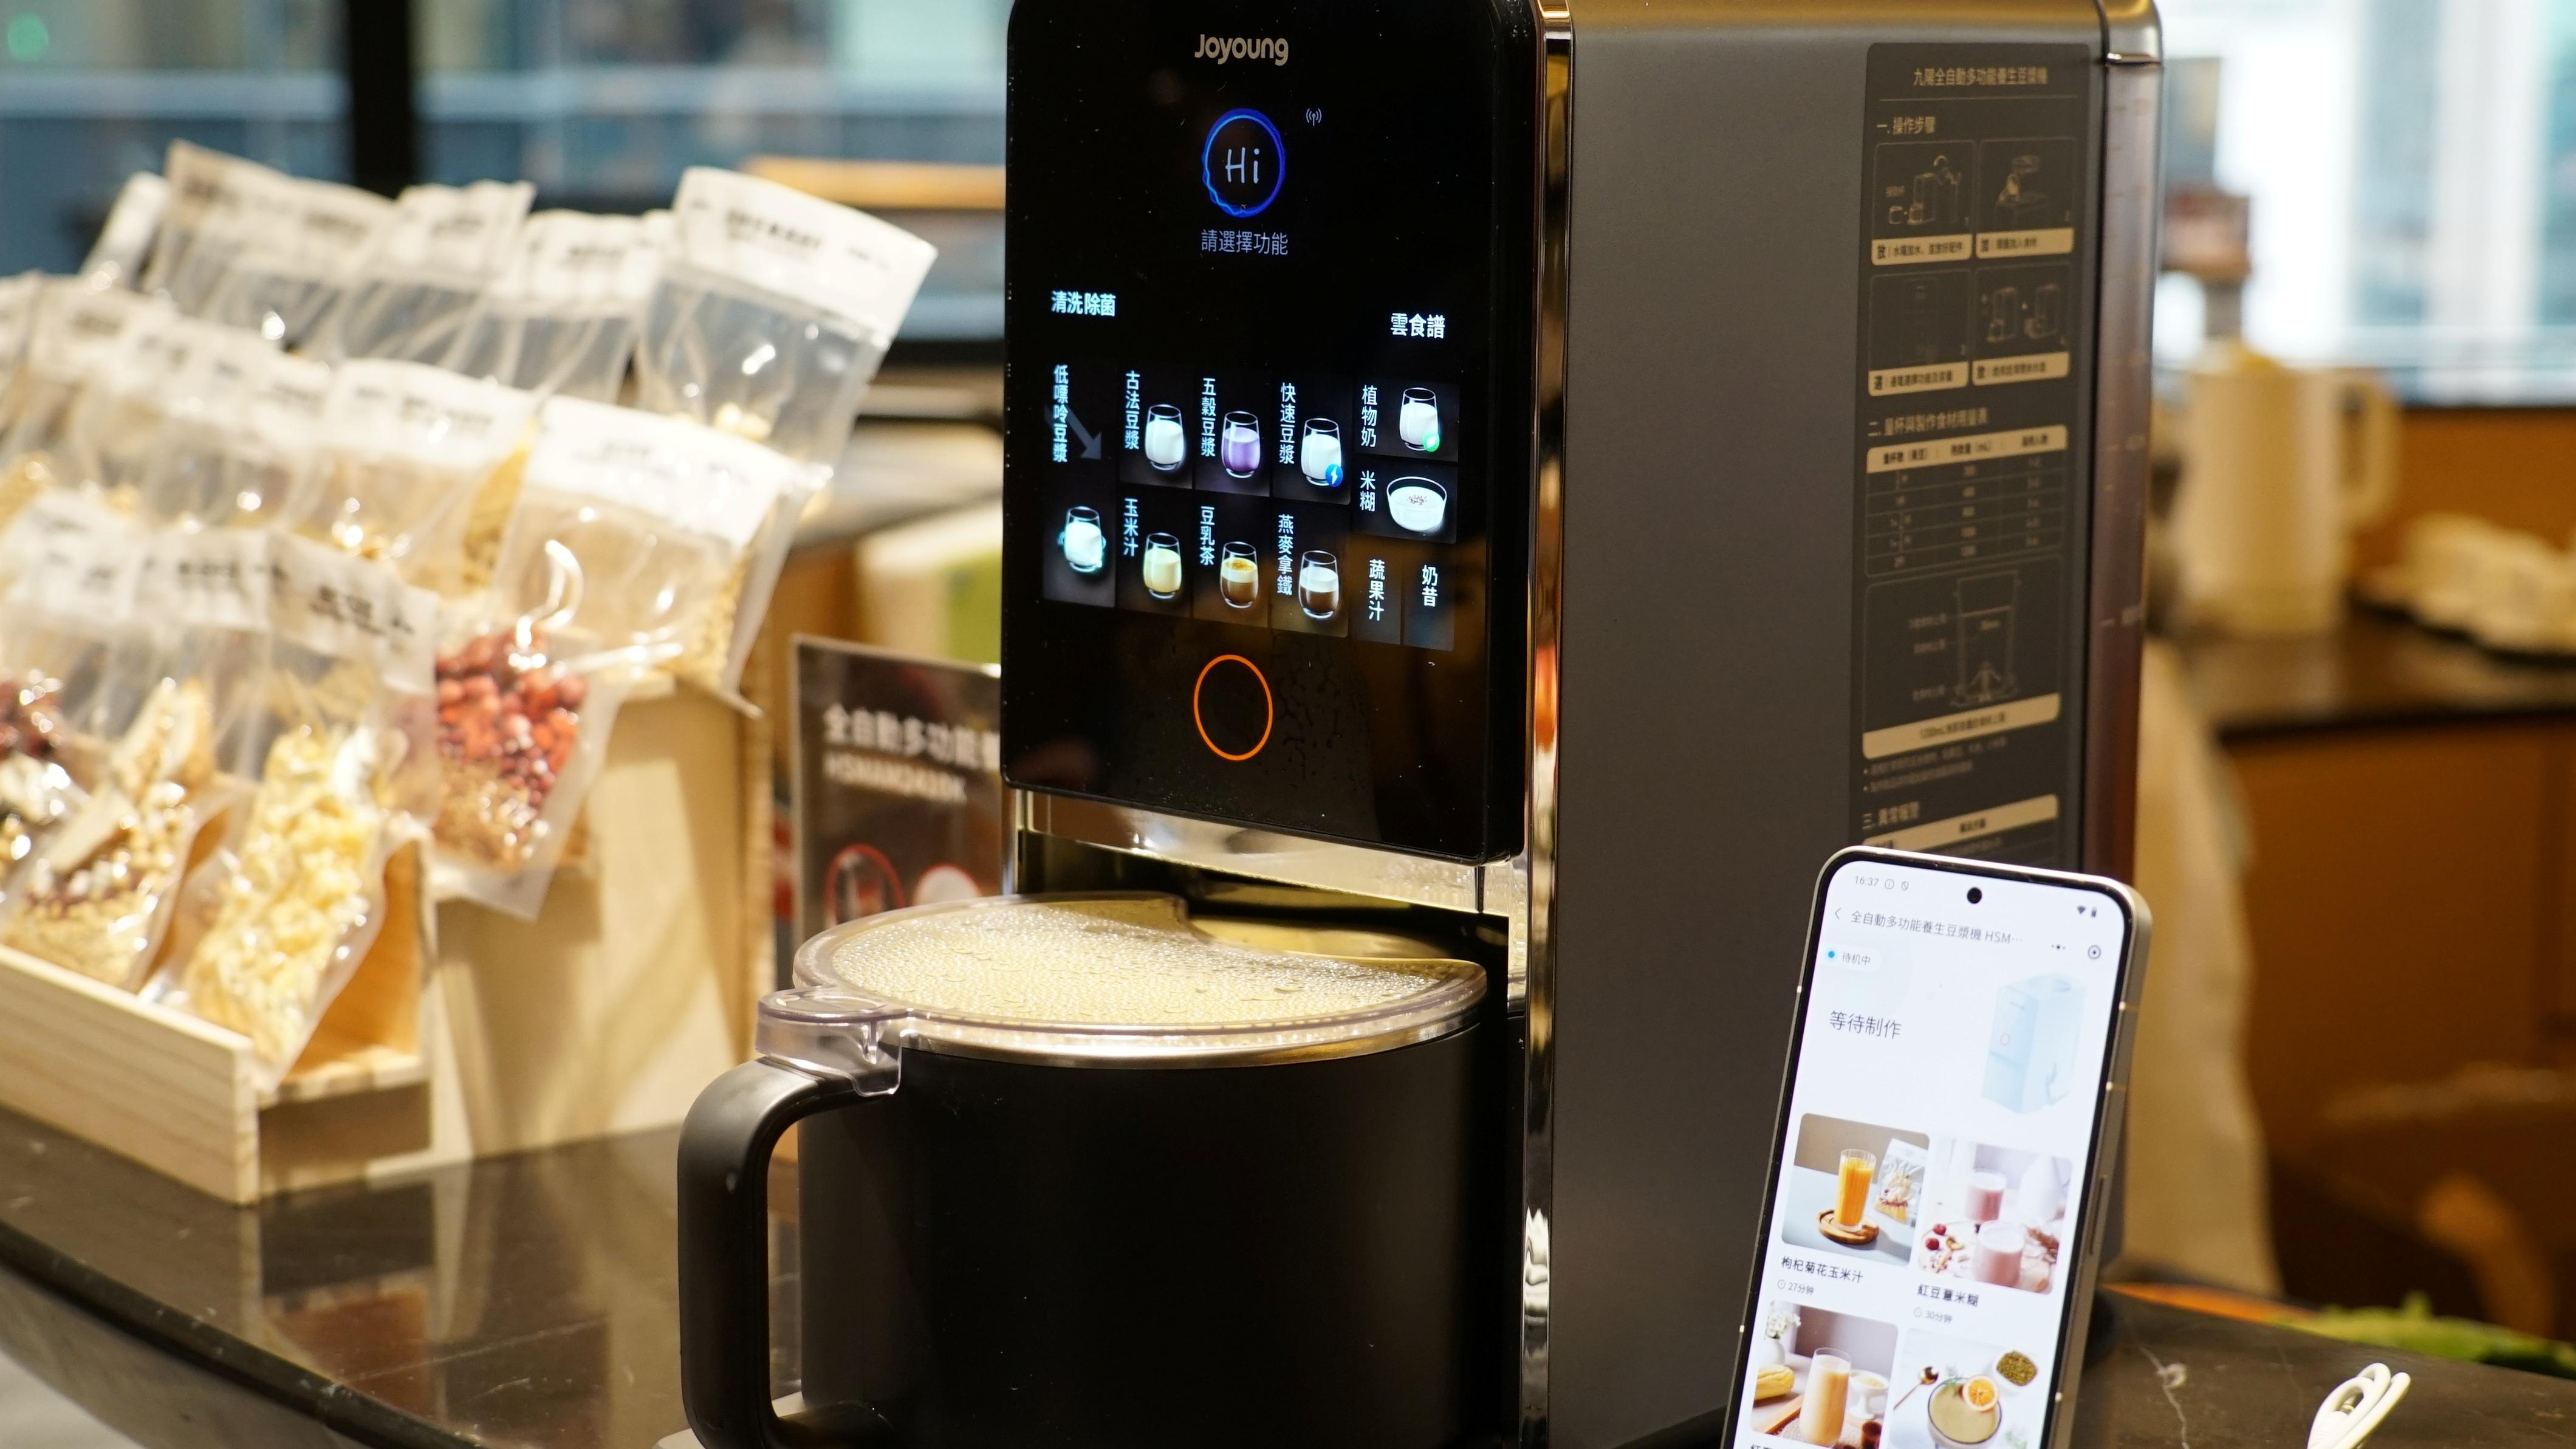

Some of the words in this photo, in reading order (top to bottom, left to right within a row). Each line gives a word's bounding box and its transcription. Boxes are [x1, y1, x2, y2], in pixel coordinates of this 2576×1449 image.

[1194, 33, 1289, 66] Joyoung
[1225, 147, 1260, 184] Hi
[1201, 229, 1289, 255] 請選擇功能
[1051, 290, 1116, 317] 清洗除菌
[1390, 313, 1445, 339] 雲食譜
[1053, 365, 1069, 462] 低嘌呤豆漿
[1125, 370, 1140, 450] 古法豆漿
[1201, 377, 1217, 457] 五穀豆漿
[1279, 382, 1297, 464] 快速豆漿
[1361, 385, 1379, 448] 植物奶
[1359, 470, 1376, 512] 米糊
[1123, 498, 1139, 557] 玉米汁
[1199, 505, 1216, 566] 豆乳茶
[1276, 513, 1294, 596] 燕麥拿鐵
[1368, 559, 1386, 622] 蔬果汁
[1421, 564, 1439, 608] 奶昔
[1855, 875, 1879, 886] 16:37
[1851, 910, 1981, 941] 全自動多功能養生豆漿機
[1842, 952, 1871, 965] 待机中
[1830, 1010, 1902, 1040] 等待制作
[1781, 1256, 1863, 1284] 枸杞菊花玉米汁
